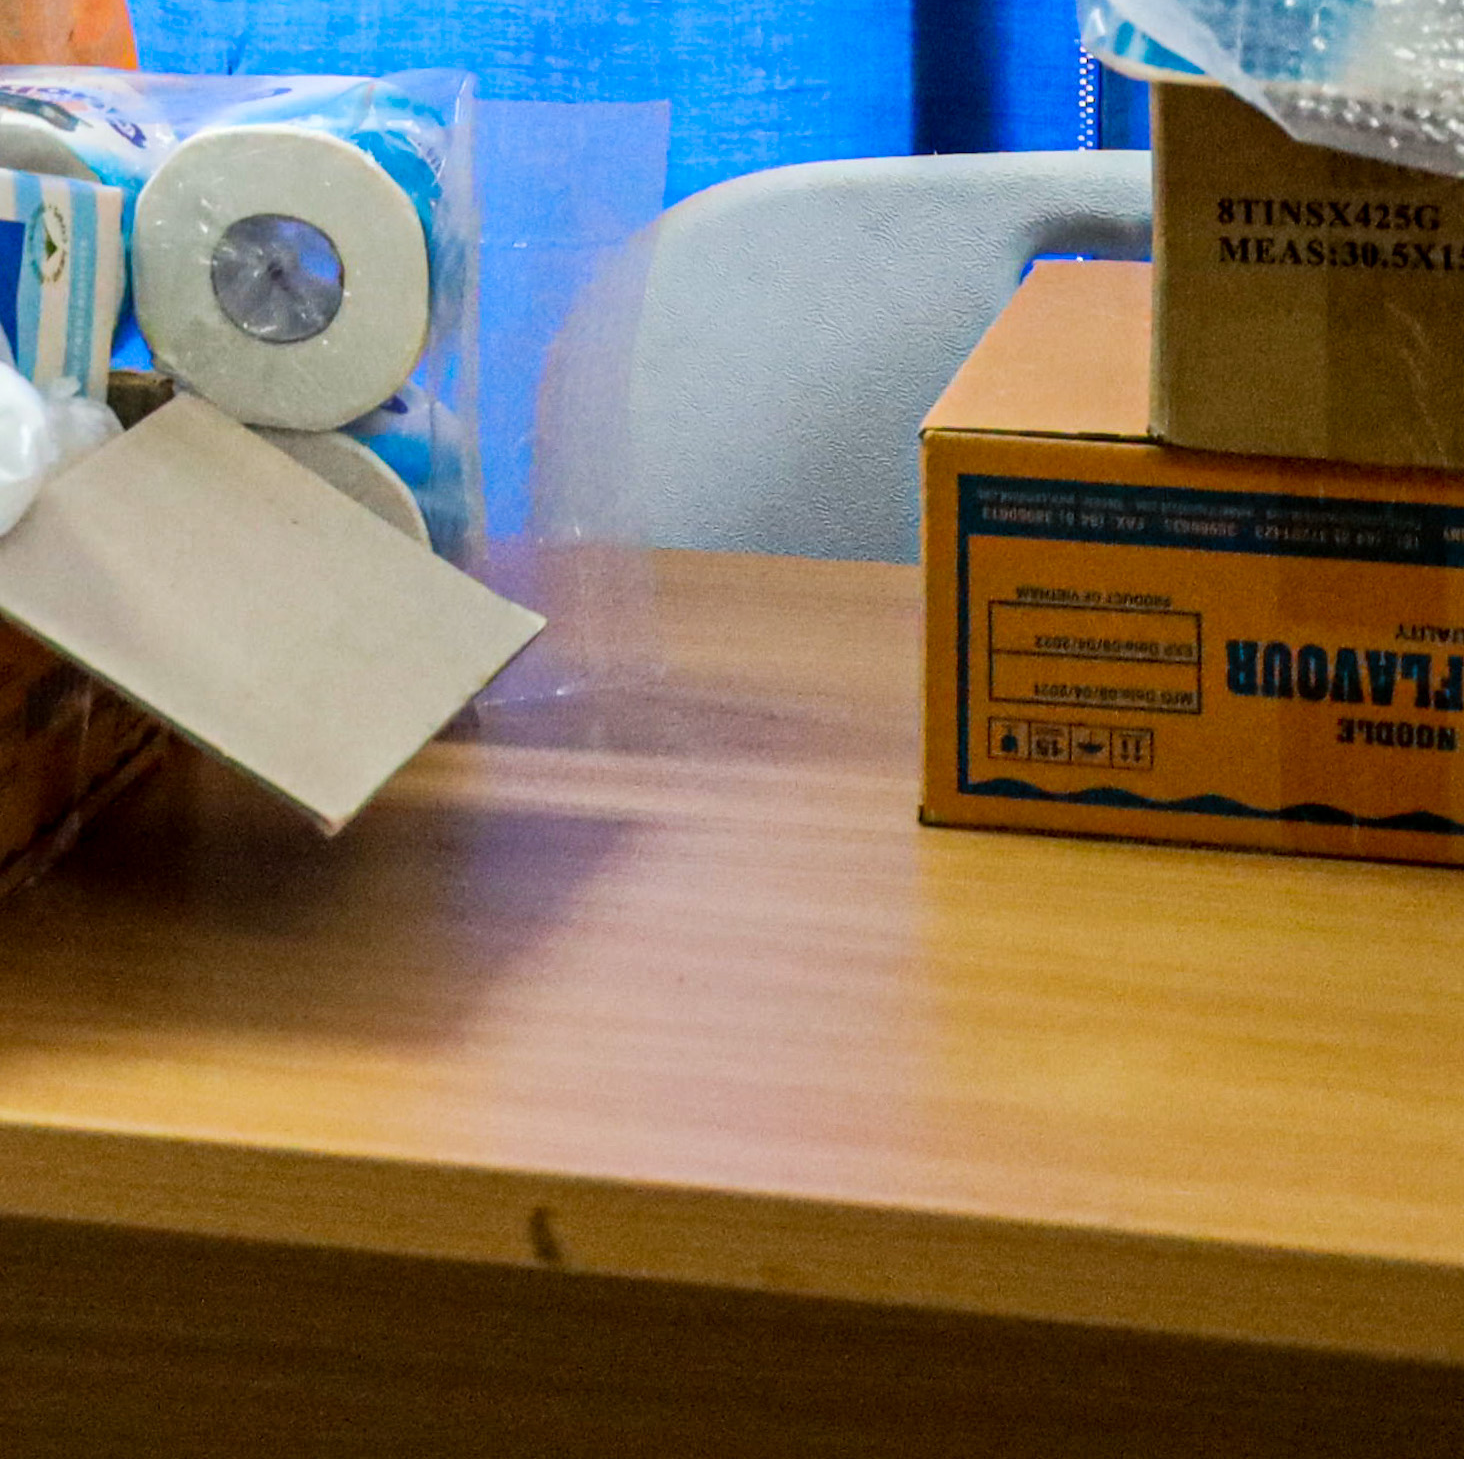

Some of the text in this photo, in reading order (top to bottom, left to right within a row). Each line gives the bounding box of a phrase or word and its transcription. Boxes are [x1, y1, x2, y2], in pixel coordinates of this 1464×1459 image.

[1216, 197, 1441, 231] 8TINSX425G
[1106, 594, 1172, 608] PRODUCT
[1225, 639, 1464, 712] FLAVOUR
[1336, 716, 1456, 752] NOODLE
